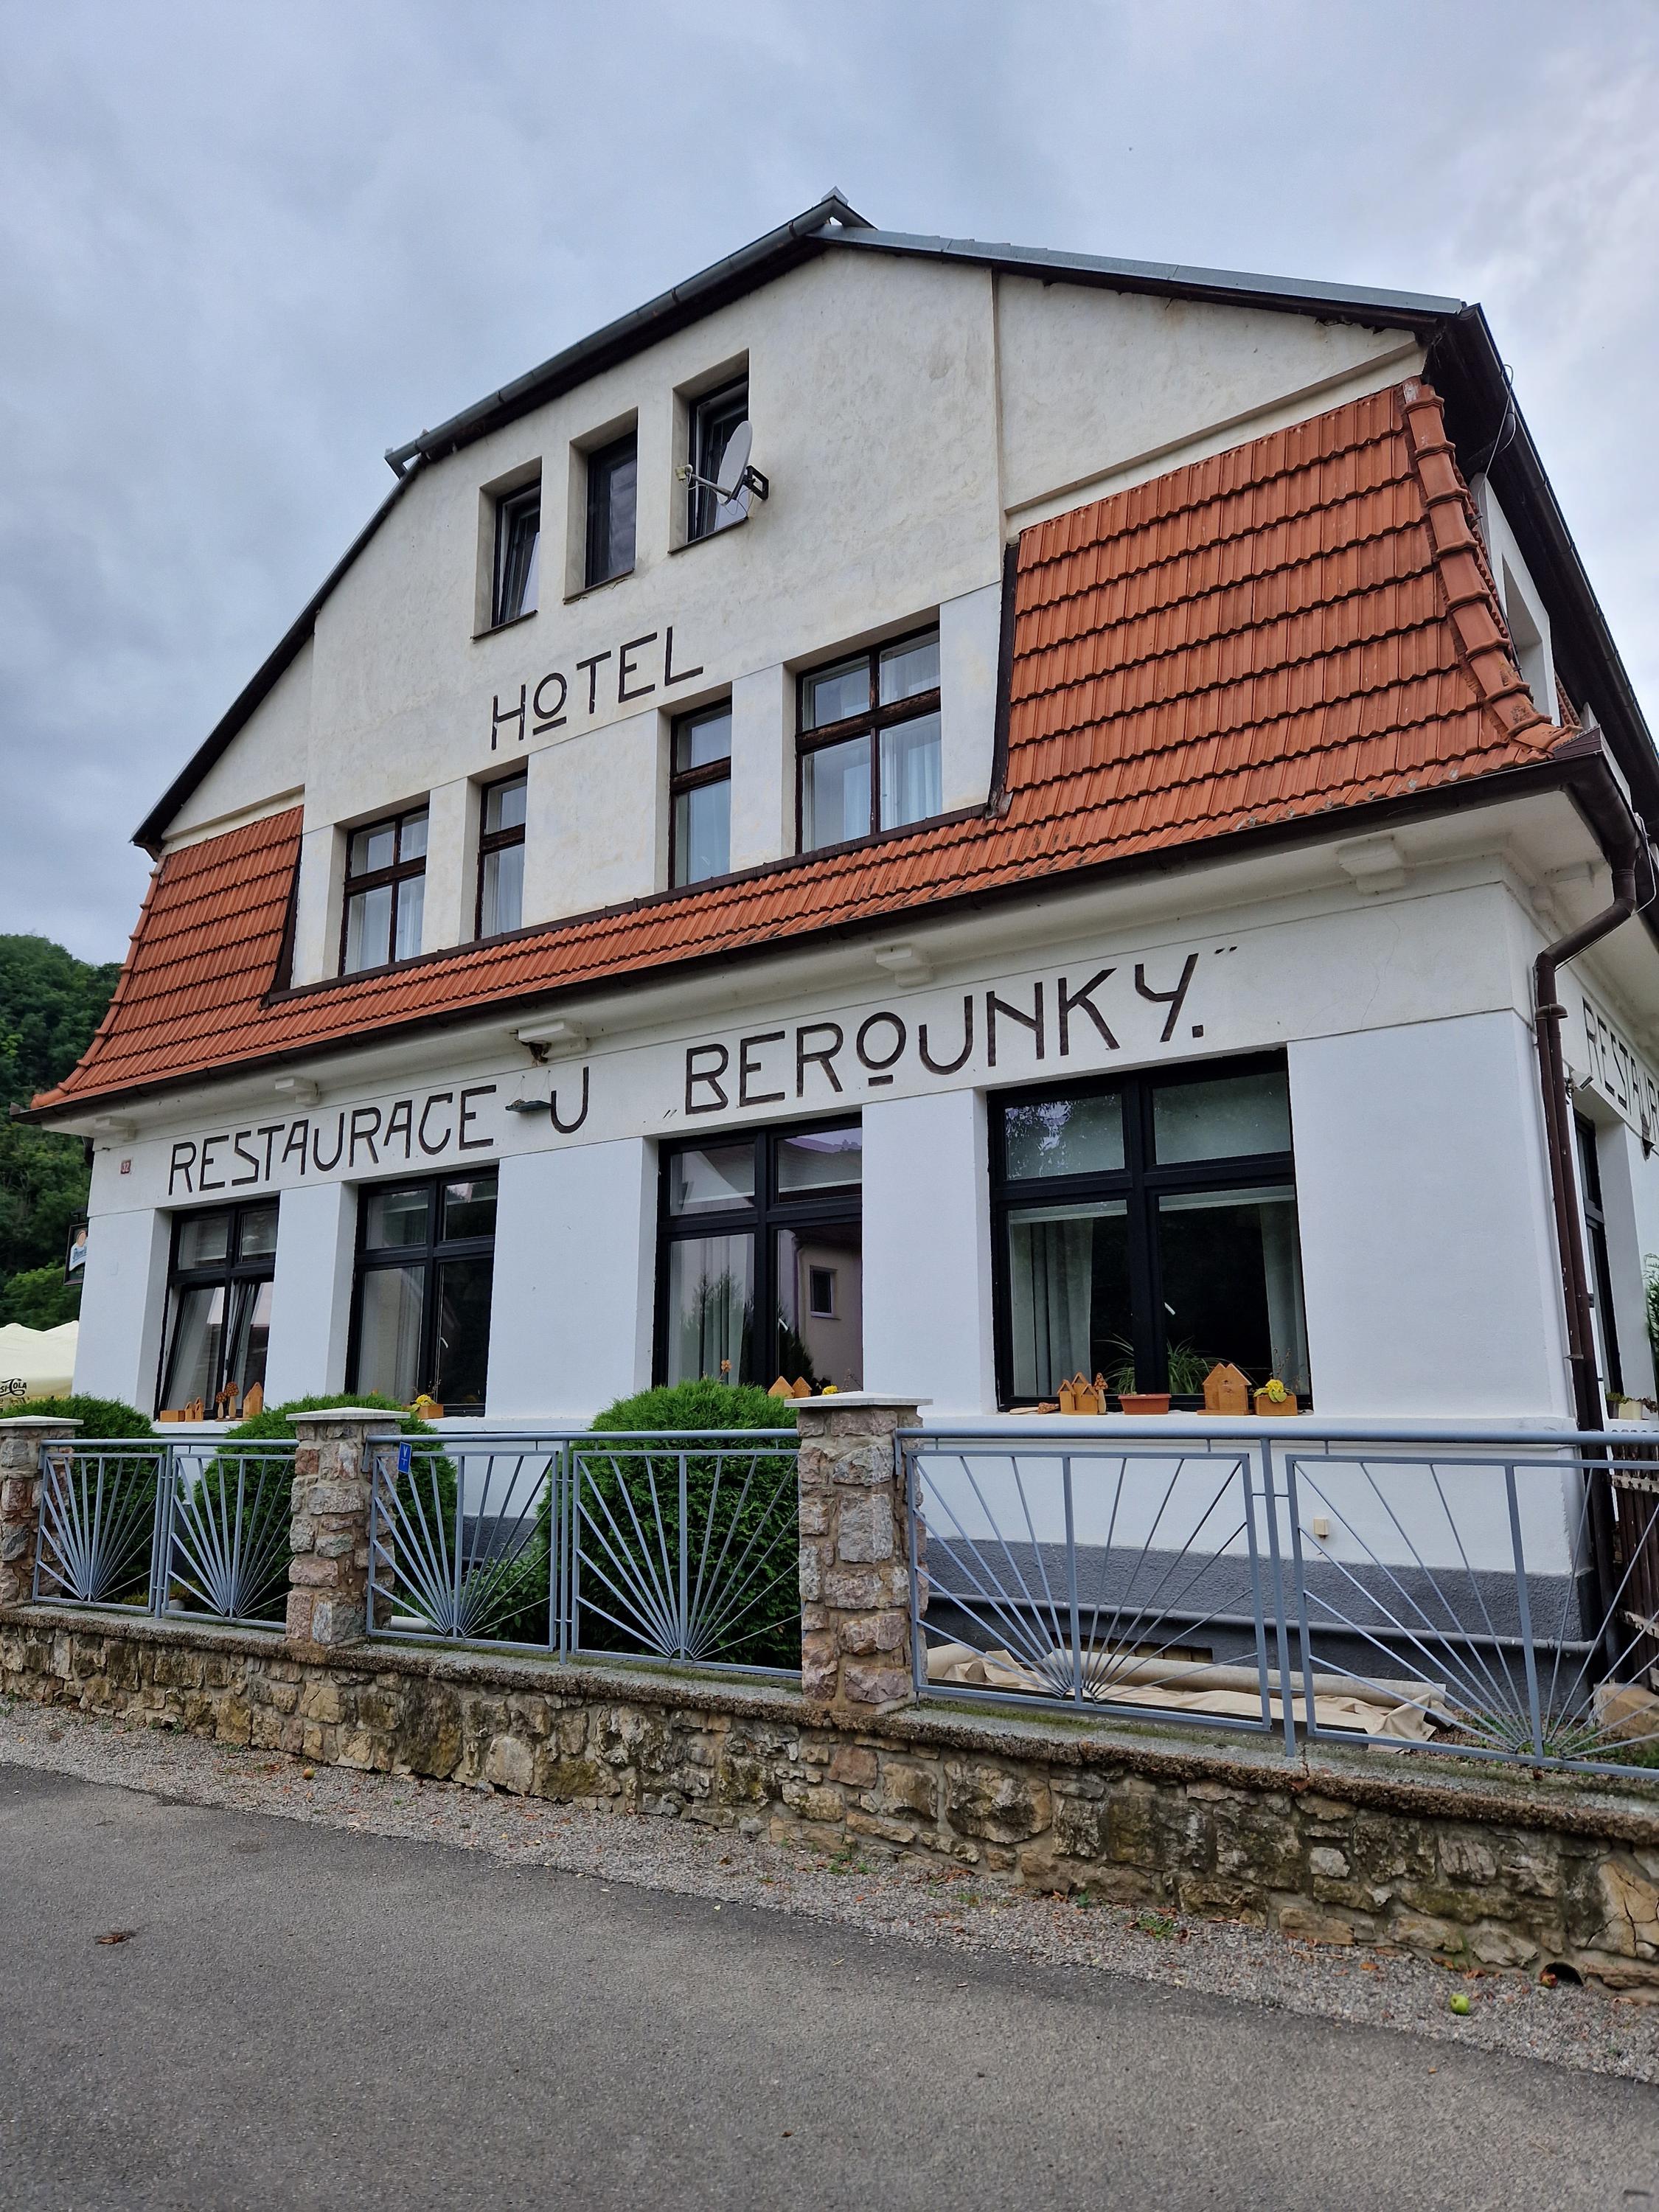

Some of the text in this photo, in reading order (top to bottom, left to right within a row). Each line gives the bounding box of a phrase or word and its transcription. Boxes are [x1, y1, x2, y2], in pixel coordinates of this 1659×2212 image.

[492, 626, 703, 751] HOTEL
[169, 1085, 497, 1196] RESTAURACE
[551, 1066, 589, 1134] U
[1582, 995, 1659, 1142] RESTAUR
